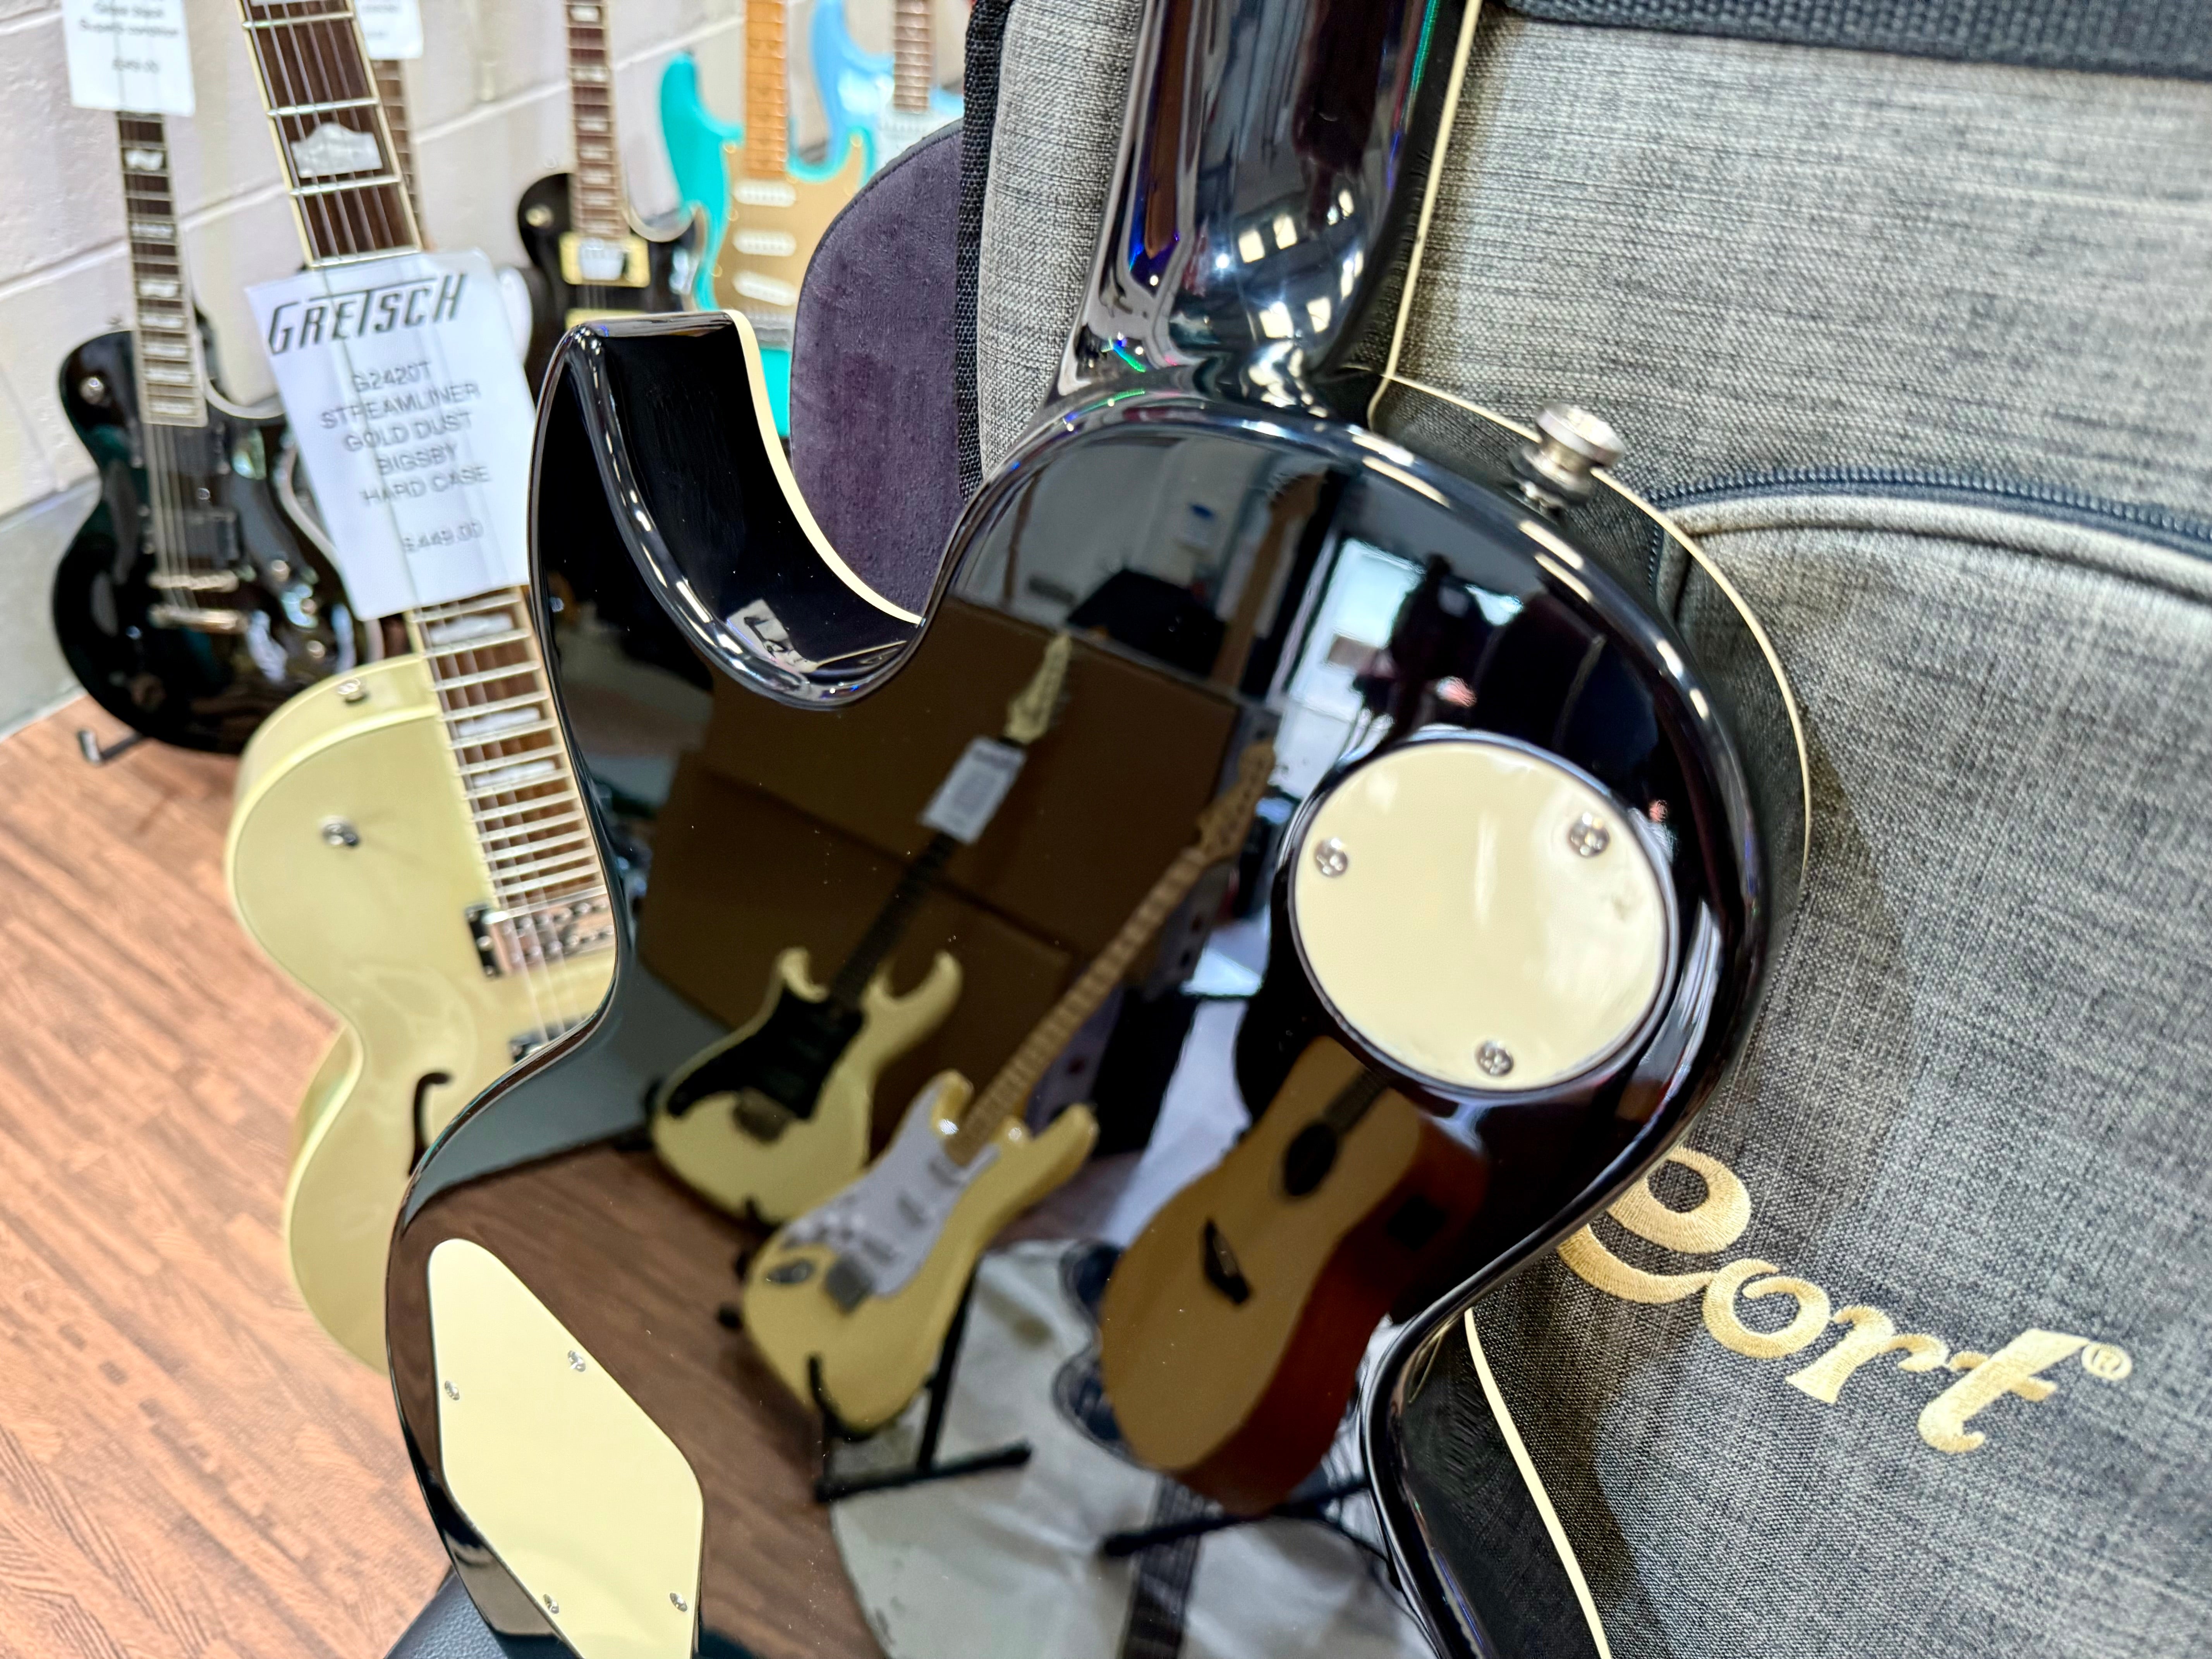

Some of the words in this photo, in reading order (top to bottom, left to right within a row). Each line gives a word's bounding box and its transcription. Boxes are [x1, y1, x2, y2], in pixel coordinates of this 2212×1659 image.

[268, 272, 468, 355] GRETSCH
[352, 361, 432, 393] G2420T
[320, 381, 482, 429] STREAMLINER
[343, 422, 409, 452] GOLD
[413, 411, 473, 439] DUST
[377, 441, 458, 475] BIGSBY
[360, 477, 426, 505] HARD
[431, 465, 491, 492] CASE
